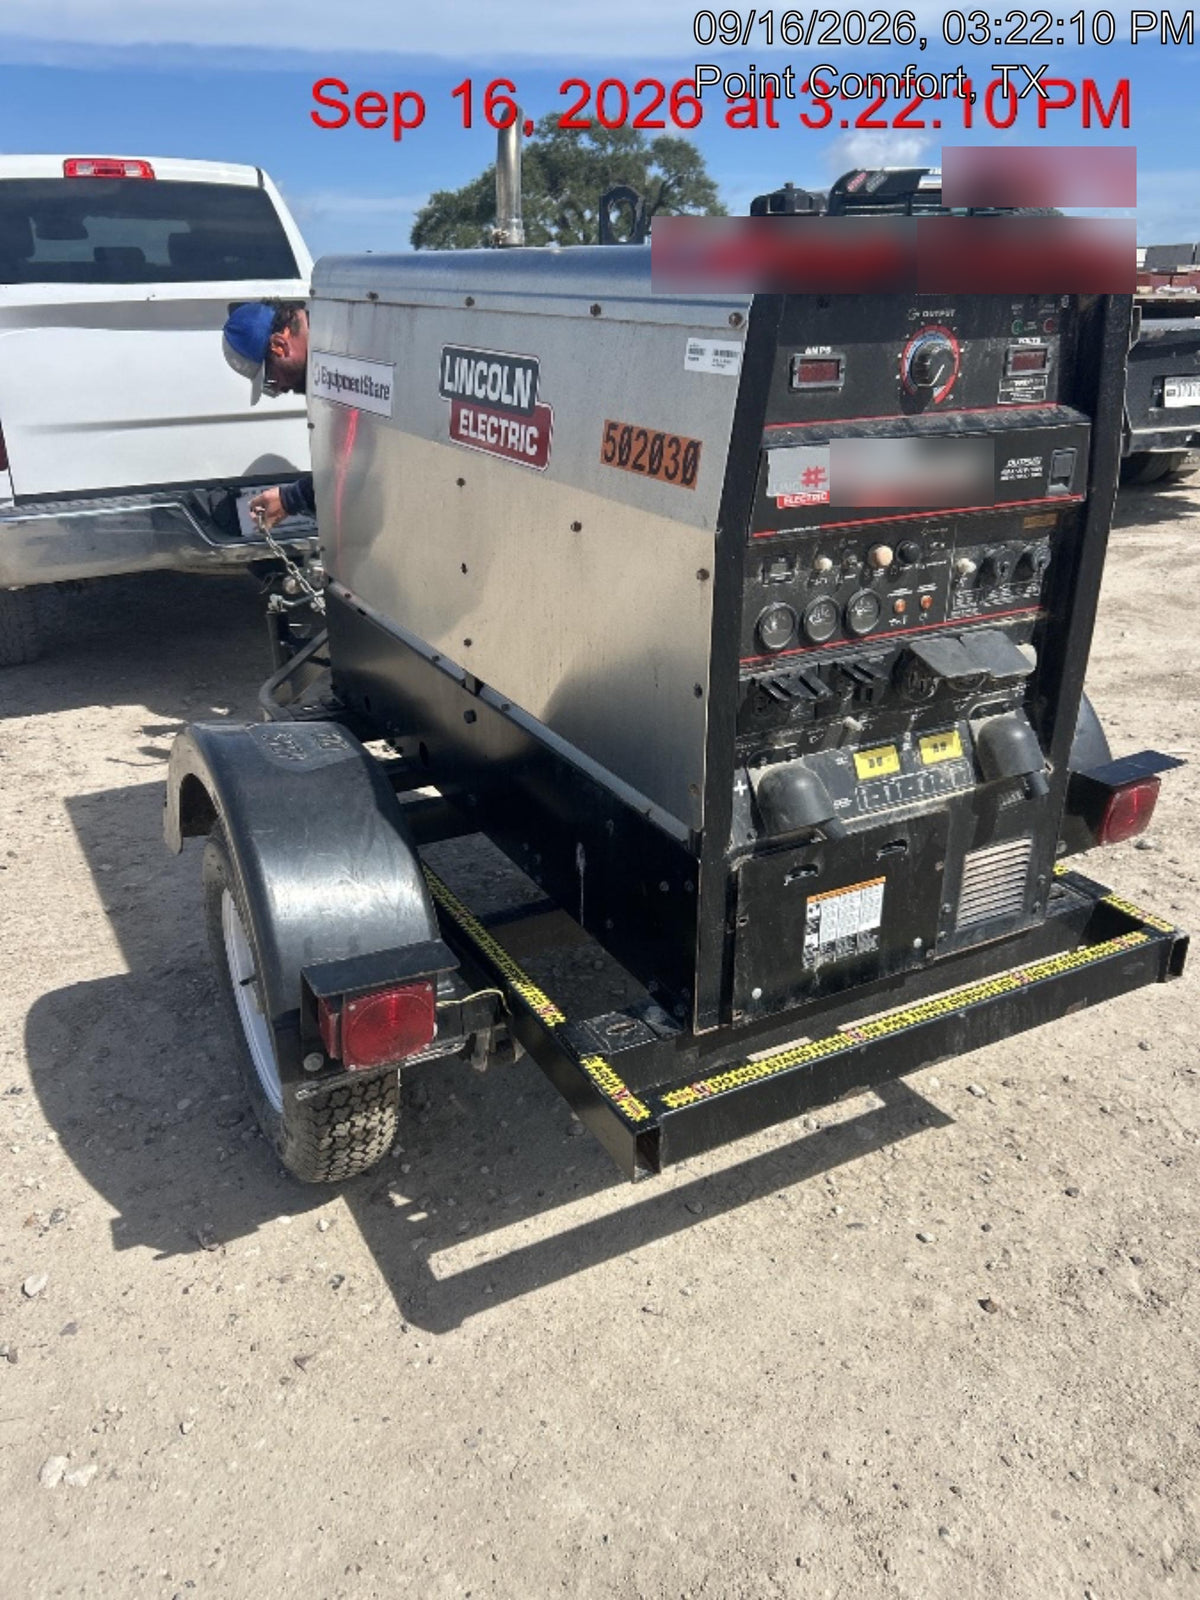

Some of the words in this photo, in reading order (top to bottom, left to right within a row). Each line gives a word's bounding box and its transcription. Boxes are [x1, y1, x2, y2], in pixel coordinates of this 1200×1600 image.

[321, 365, 391, 401] EquipmentShare
[443, 354, 533, 410] LINCOLN
[458, 408, 540, 456] ELECTRIC
[603, 422, 702, 486] 502030
[711, 1074, 733, 1090] DO
